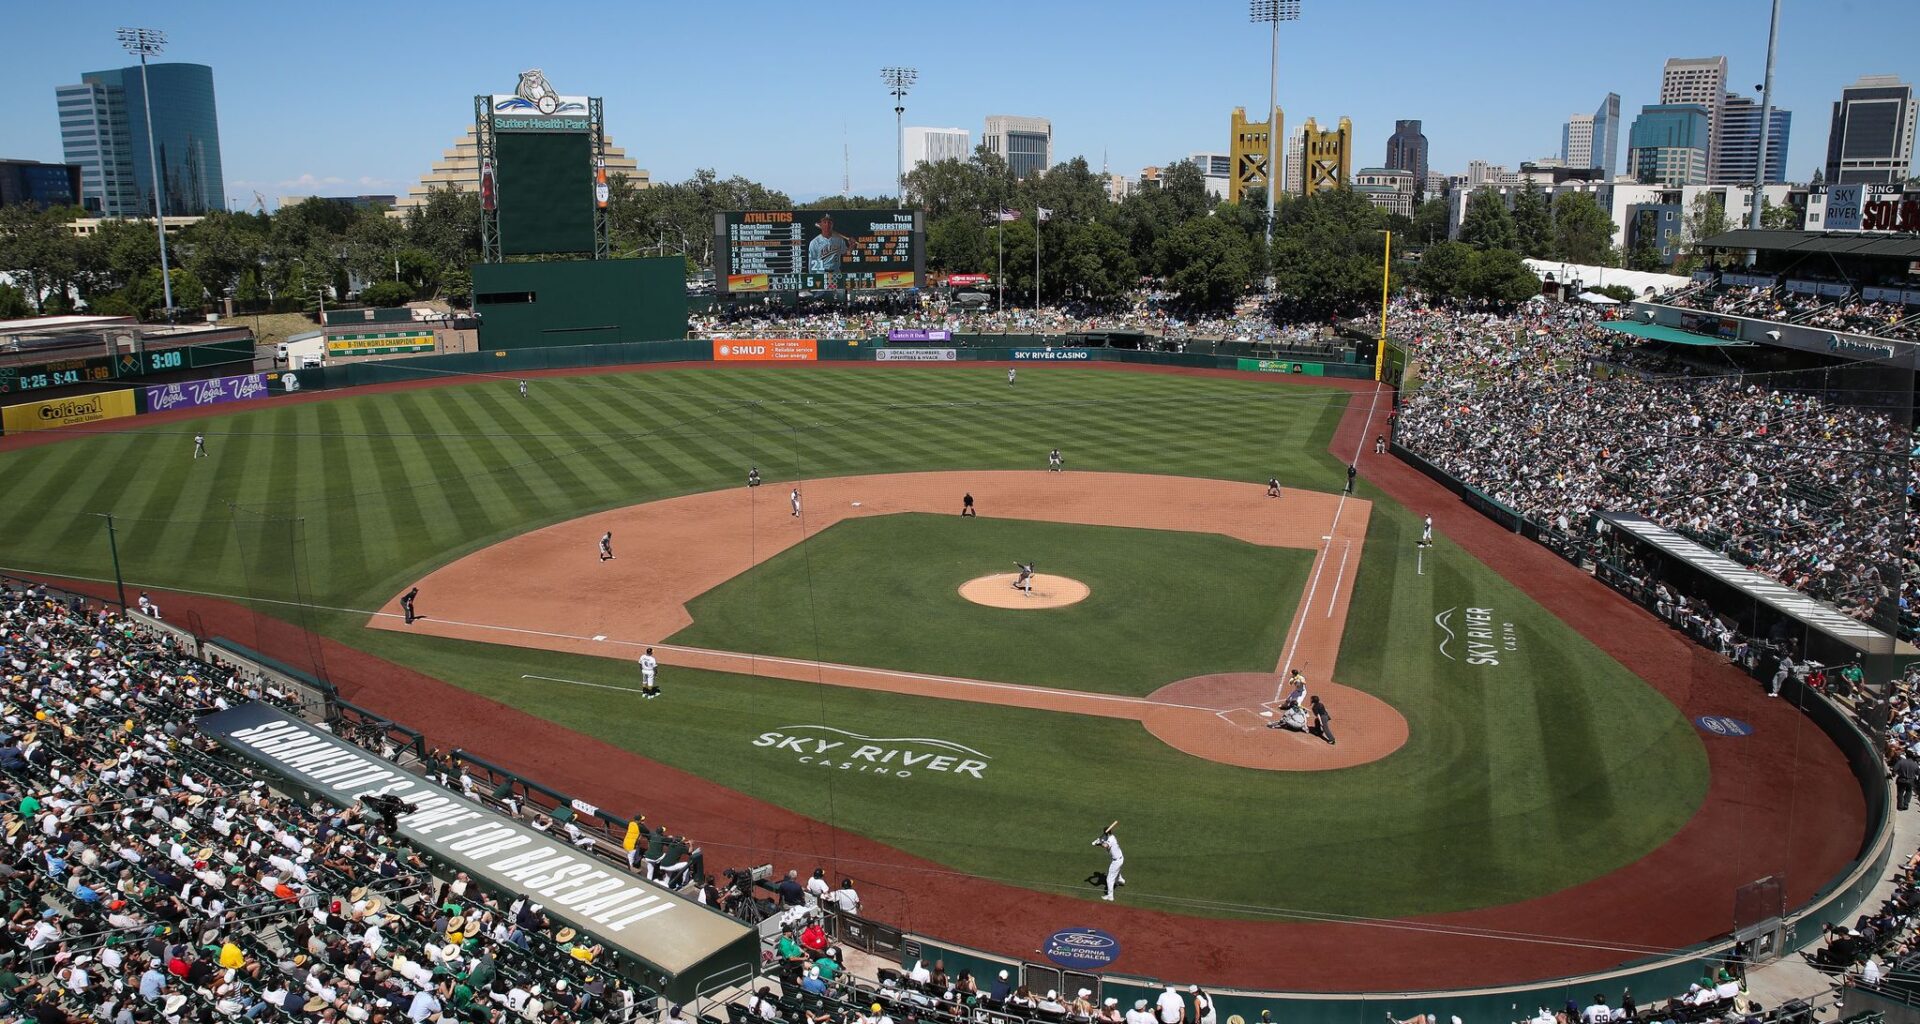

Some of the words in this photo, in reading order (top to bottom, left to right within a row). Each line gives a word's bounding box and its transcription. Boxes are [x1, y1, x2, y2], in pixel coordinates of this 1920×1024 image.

[495, 118, 529, 128] Sutter
[530, 118, 564, 128] Health
[565, 119, 589, 128] Park
[1834, 190, 1855, 202] SKY
[1867, 186, 1894, 194] SING
[744, 212, 793, 223] ATHLETICS
[1828, 208, 1857, 220] RIVER
[870, 222, 912, 230] SODERSTROM
[811, 260, 825, 270] 21
[807, 277, 814, 286] 5
[732, 346, 765, 355] SMUD
[152, 352, 180, 369] 3:00
[20, 374, 47, 389] B:25
[53, 370, 79, 384] S:41
[189, 383, 227, 404] Vegas
[228, 378, 266, 399] Vegas
[148, 386, 187, 410] Vegas
[38, 404, 92, 420] Golden
[1466, 608, 1494, 639] RIVER
[1503, 623, 1517, 650] CASINO
[1466, 641, 1499, 666] SKY
[752, 732, 844, 753] SKY
[851, 745, 988, 779] RIVER
[799, 756, 912, 777] CASINO
[230, 720, 415, 800] SACRAMENTO'S
[435, 821, 532, 860] FOR
[488, 846, 677, 932] BASEBALL
[1064, 934, 1103, 946] Ford
[1073, 952, 1110, 961] DEALERS
